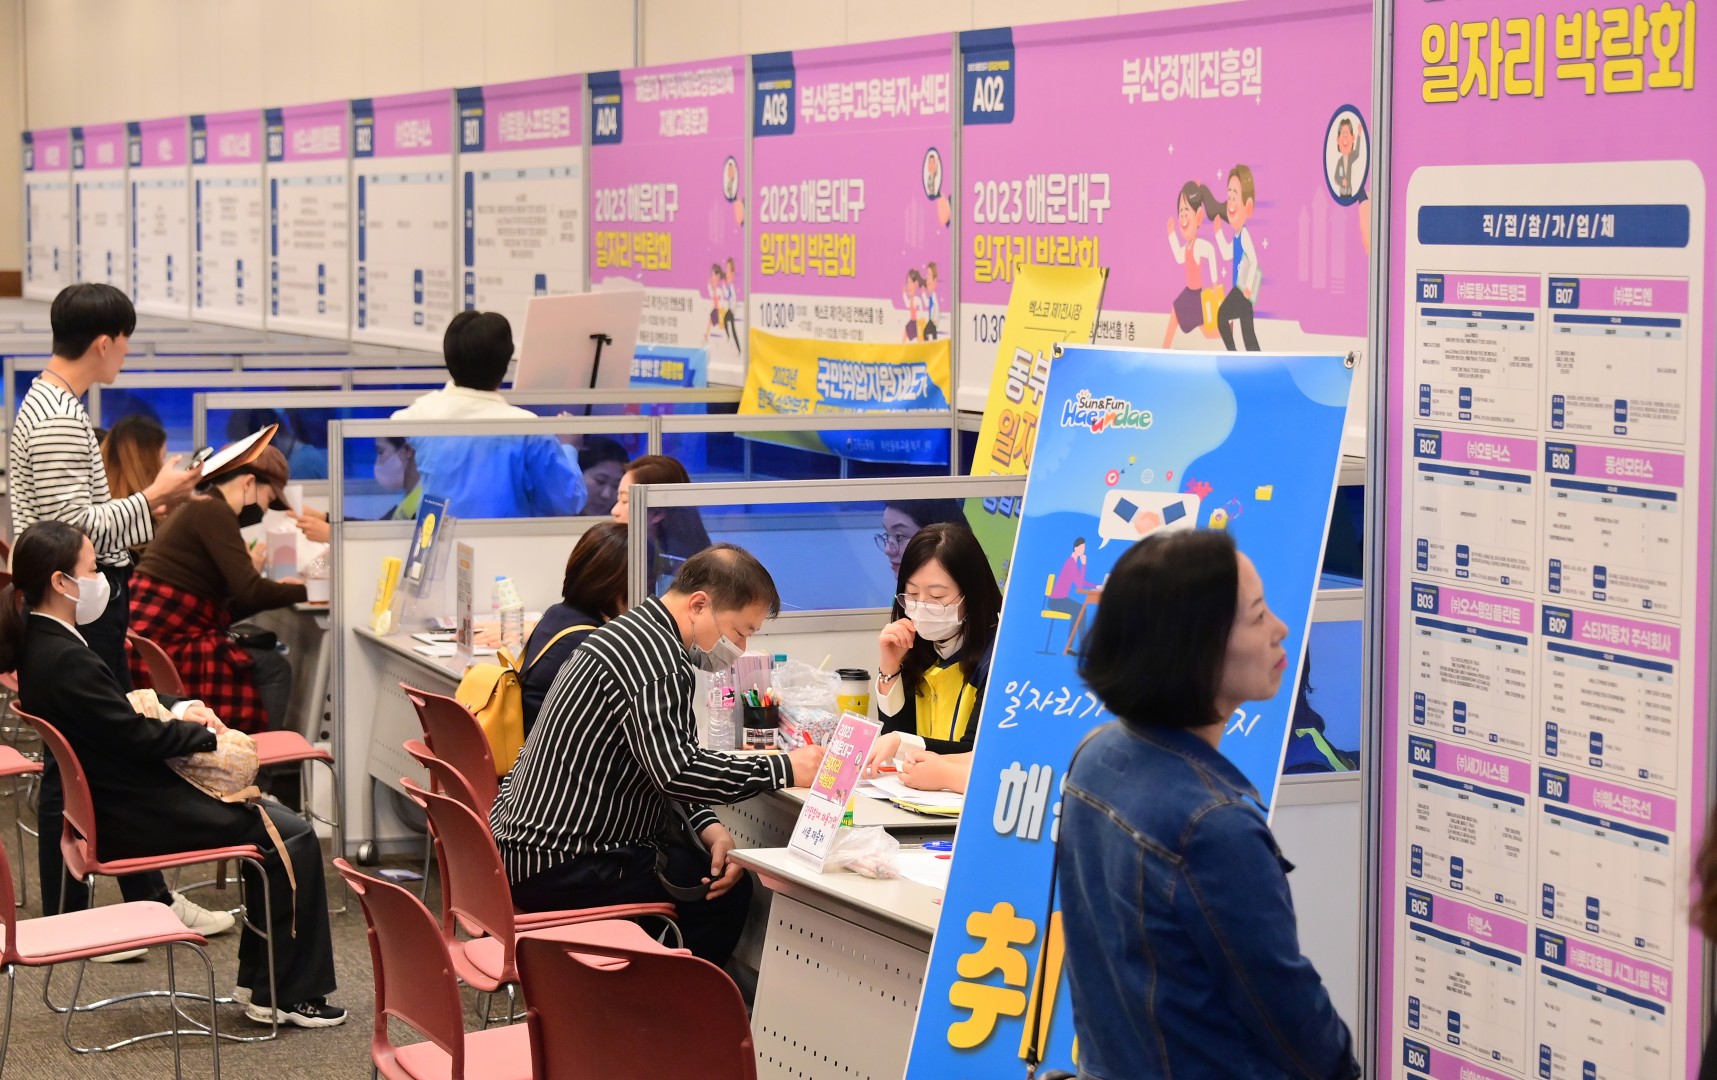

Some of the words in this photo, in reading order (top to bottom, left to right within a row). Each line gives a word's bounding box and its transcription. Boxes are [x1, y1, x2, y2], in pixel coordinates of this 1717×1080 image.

[1421, 14, 1545, 104] 일자리
[1555, 0, 1696, 96] 박람회
[1122, 47, 1261, 104] 부산경제진흥원
[800, 73, 950, 124] 부산동부고용복지+센터
[972, 75, 1004, 112] A02
[762, 92, 788, 126] A03
[596, 107, 617, 136] A04
[595, 188, 626, 222] 2023
[627, 183, 678, 222] 해운대구
[760, 185, 798, 222] 2023
[801, 179, 865, 223] 해운대구
[973, 180, 1022, 223] 2023
[1025, 173, 1111, 224] 해운대구
[1482, 213, 1615, 239] 직/접/참/가/업/체
[596, 231, 632, 268] 일자리
[634, 232, 671, 271] 박람회
[760, 234, 805, 276] 일자리
[808, 234, 856, 278] 박람회
[973, 235, 1029, 283] 일자리
[1423, 284, 1438, 298] B01
[1556, 288, 1574, 304] B07
[1029, 300, 1050, 317] 벡스코
[1050, 303, 1082, 321] 제1전시장
[817, 360, 927, 403] 국민취업지원제도
[1078, 396, 1124, 411] Sun&Fun
[1063, 400, 1152, 432] Haeundae
[1419, 439, 1436, 455] B02
[1552, 453, 1570, 470] B08
[1606, 456, 1653, 478] 동성모터스
[1417, 593, 1434, 610] B03
[1549, 617, 1567, 634] B09
[1582, 621, 1630, 646] 스타자동차
[1631, 628, 1672, 653] 주식회사
[838, 724, 854, 739] 2023
[830, 739, 854, 759] 해운대구
[1414, 747, 1431, 763] B04
[824, 755, 843, 774] 일자리
[1546, 780, 1563, 797] B10
[1411, 898, 1428, 917] B05
[1544, 941, 1558, 959] B11
[1408, 1050, 1425, 1068] B06
